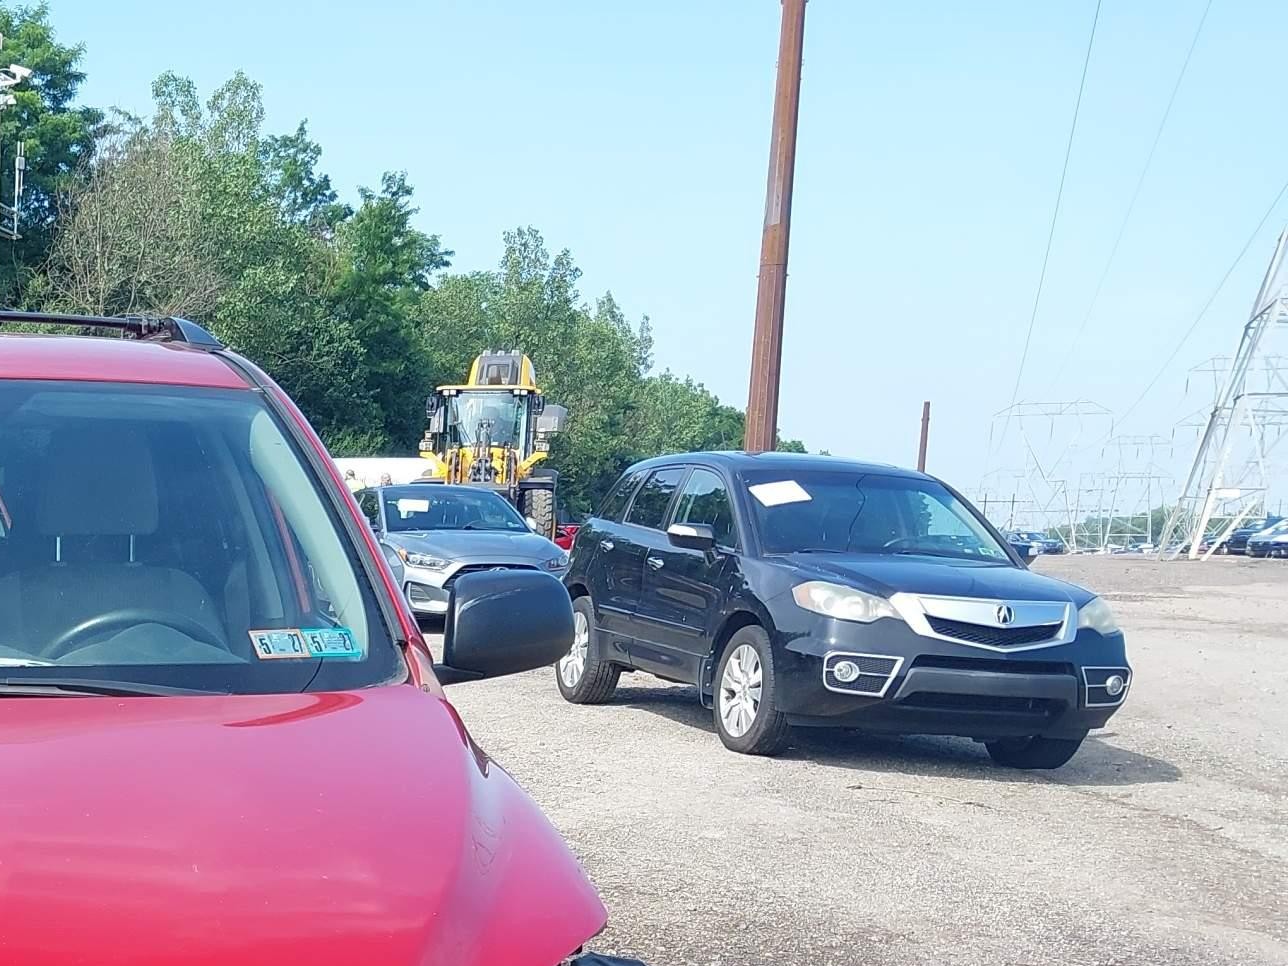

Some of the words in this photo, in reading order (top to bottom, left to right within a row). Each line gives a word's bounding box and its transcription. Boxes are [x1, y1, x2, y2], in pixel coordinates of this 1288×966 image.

[258, 637, 272, 655] 5
[287, 633, 304, 653] 27
[311, 635, 323, 652] 5
